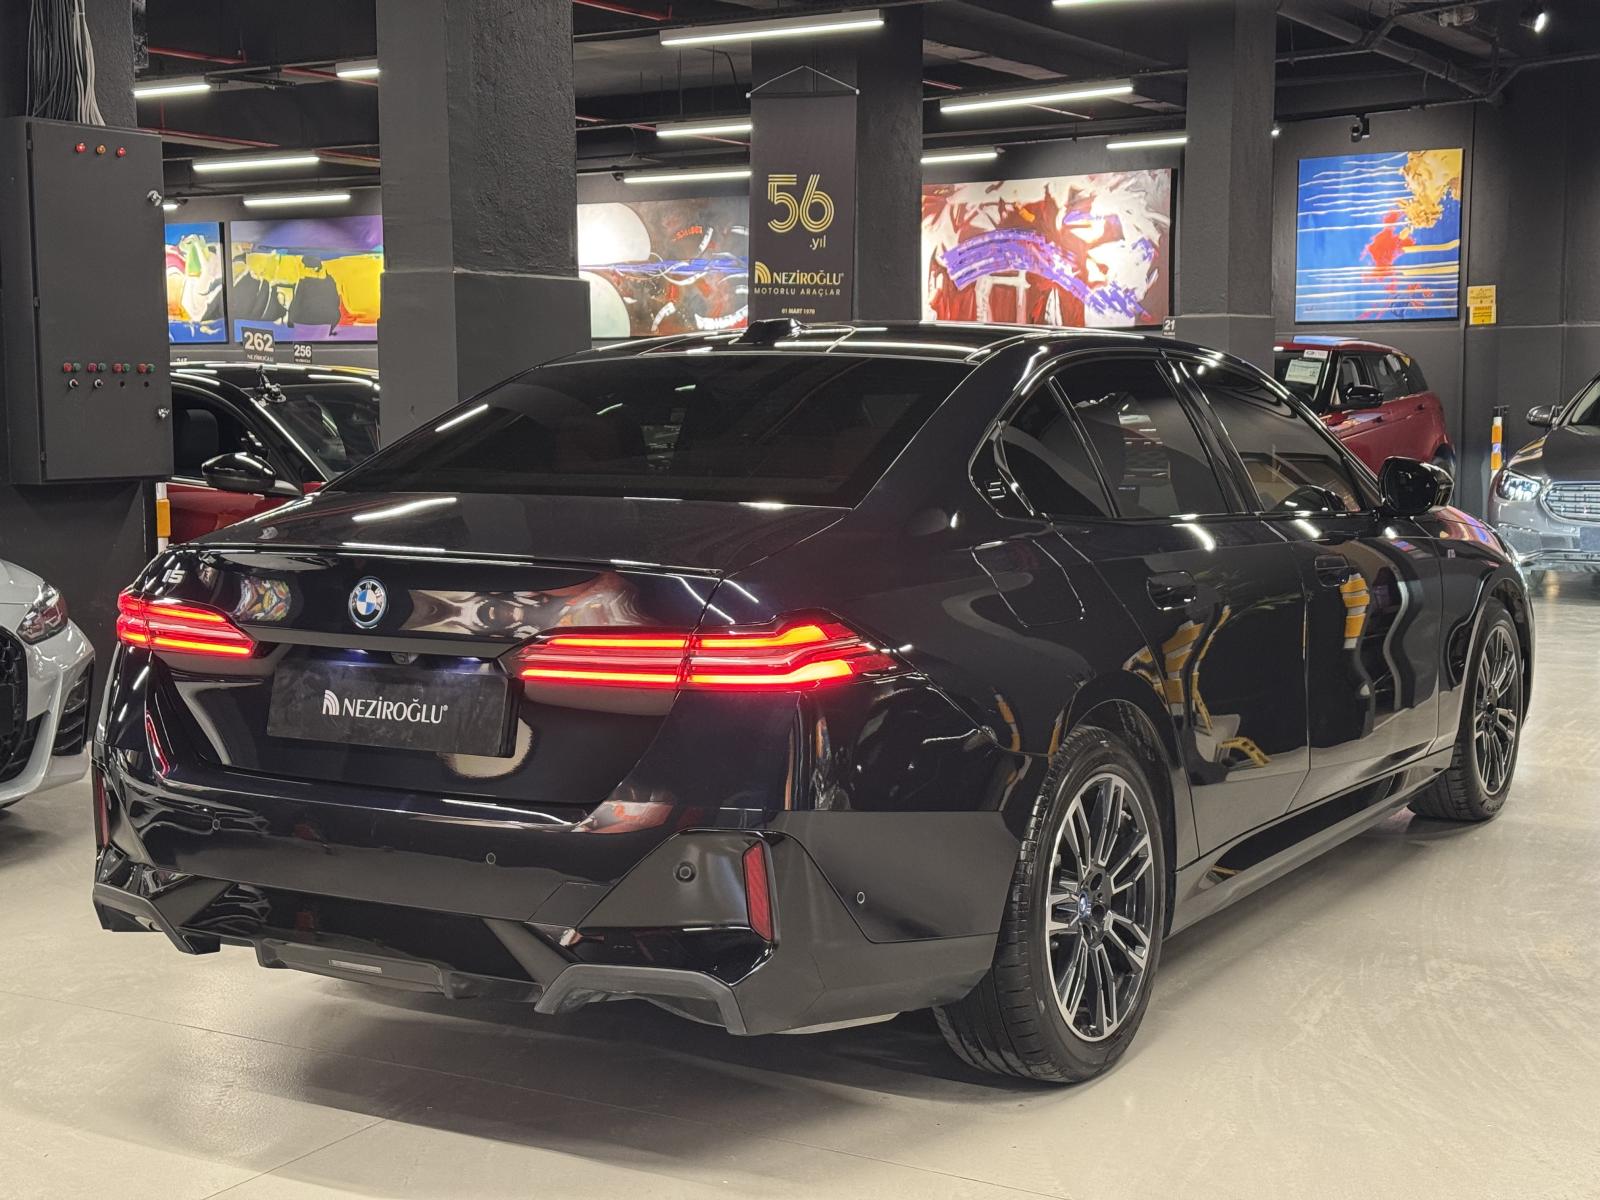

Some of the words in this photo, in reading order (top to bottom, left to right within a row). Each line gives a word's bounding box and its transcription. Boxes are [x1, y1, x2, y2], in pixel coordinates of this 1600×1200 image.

[768, 174, 835, 233] 56
[773, 270, 841, 286] NEZİROĞLU
[754, 287, 796, 295] MOTORLU
[800, 288, 841, 297] ARAÇLAR
[244, 331, 275, 353] 262
[293, 344, 312, 358] 256
[342, 696, 443, 724] NEZİROĞLU
